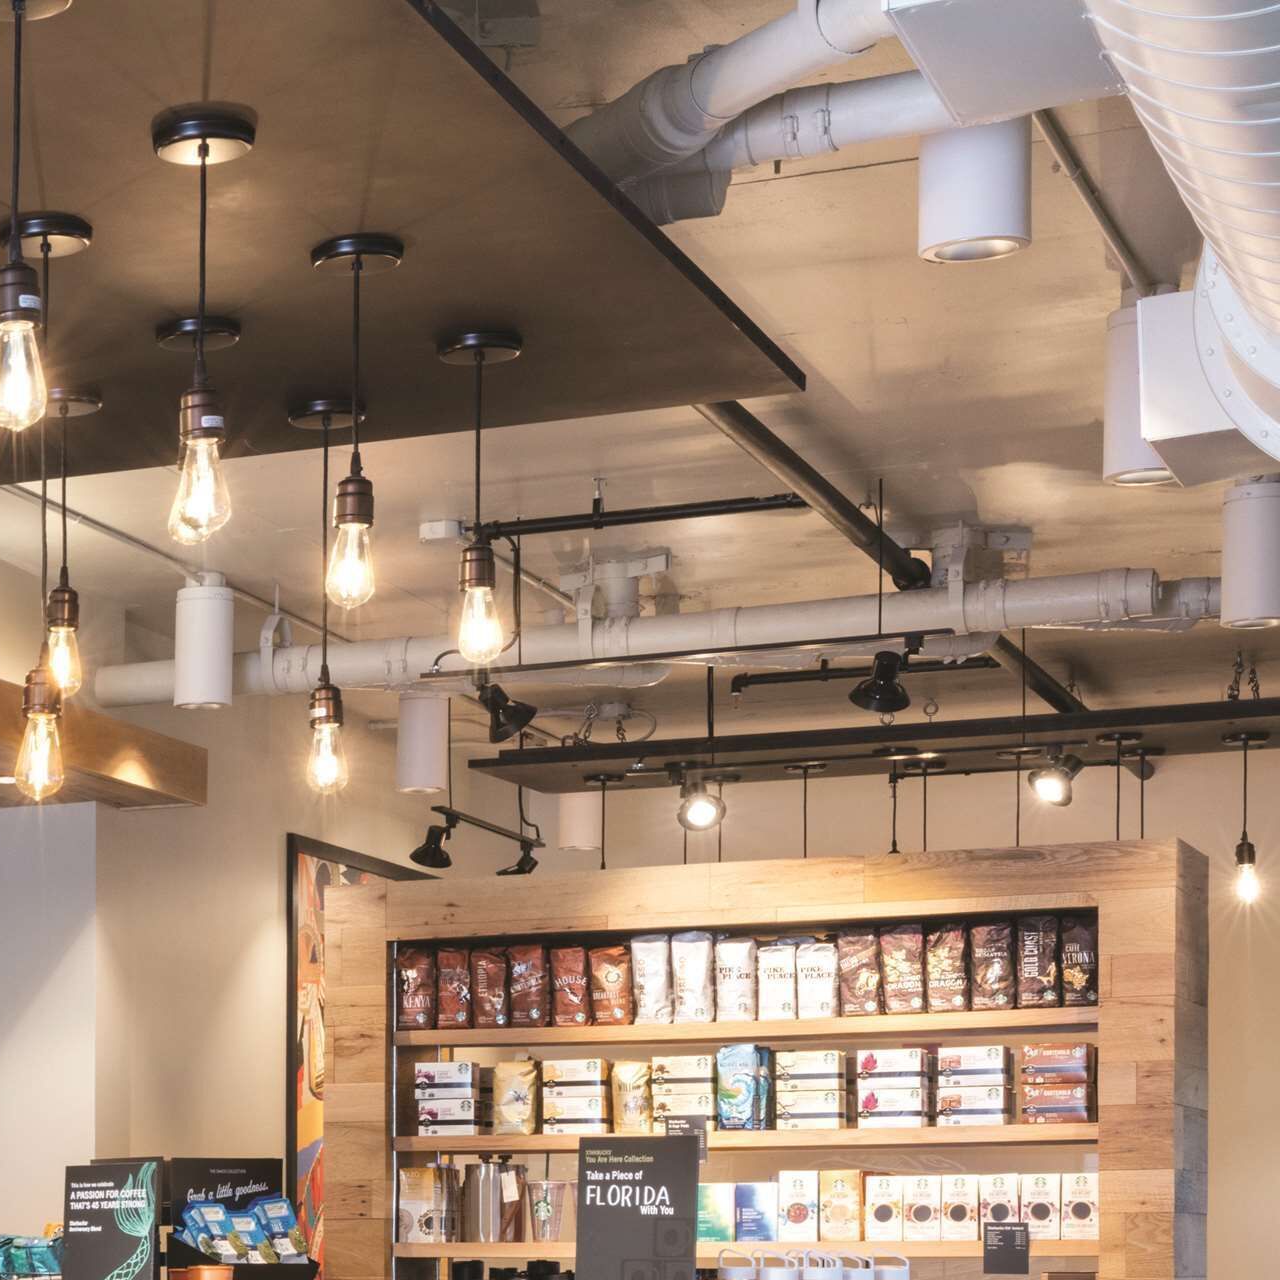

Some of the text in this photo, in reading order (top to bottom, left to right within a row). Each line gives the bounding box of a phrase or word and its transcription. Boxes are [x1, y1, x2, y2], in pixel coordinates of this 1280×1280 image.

[1062, 951, 1096, 964] VERONA
[1024, 956, 1039, 978] GOLD
[478, 960, 488, 998] ETHIOPIA
[554, 975, 587, 988] HOUSE
[403, 995, 431, 1008] KENYA
[586, 1171, 603, 1180] Take
[612, 1171, 633, 1180] Piece
[634, 1170, 643, 1179] of
[70, 1189, 146, 1200] A PASSION FOR COFFEE
[208, 1192, 214, 1200] a
[216, 1182, 233, 1199] little
[235, 1180, 269, 1202] goodness.
[586, 1184, 670, 1207] FLORIDA
[70, 1200, 146, 1210] THAT'S 45 YEARS STRONG
[640, 1205, 674, 1215] With You
